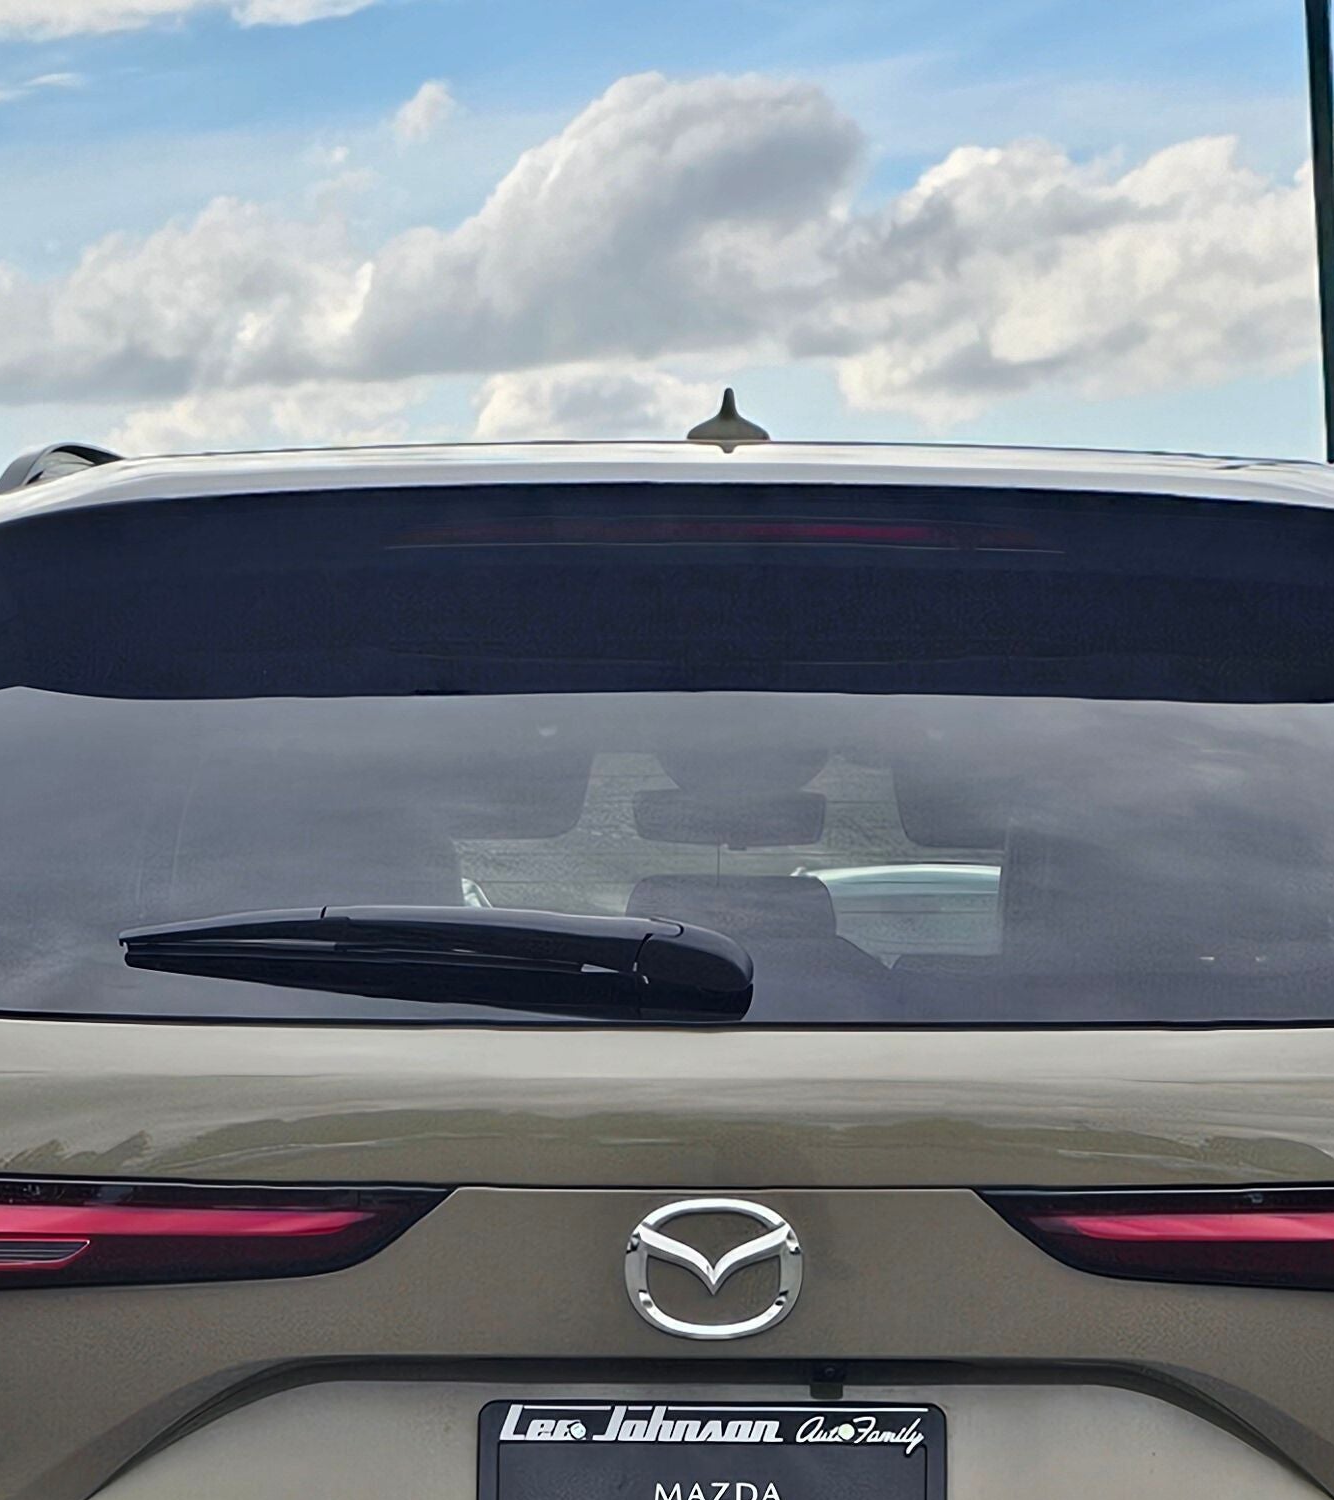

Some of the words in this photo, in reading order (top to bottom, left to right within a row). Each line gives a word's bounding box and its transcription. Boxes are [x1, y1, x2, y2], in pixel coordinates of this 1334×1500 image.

[592, 1405, 784, 1442] Johnson
[795, 1415, 855, 1443] Aut
[852, 1415, 925, 1455] Family
